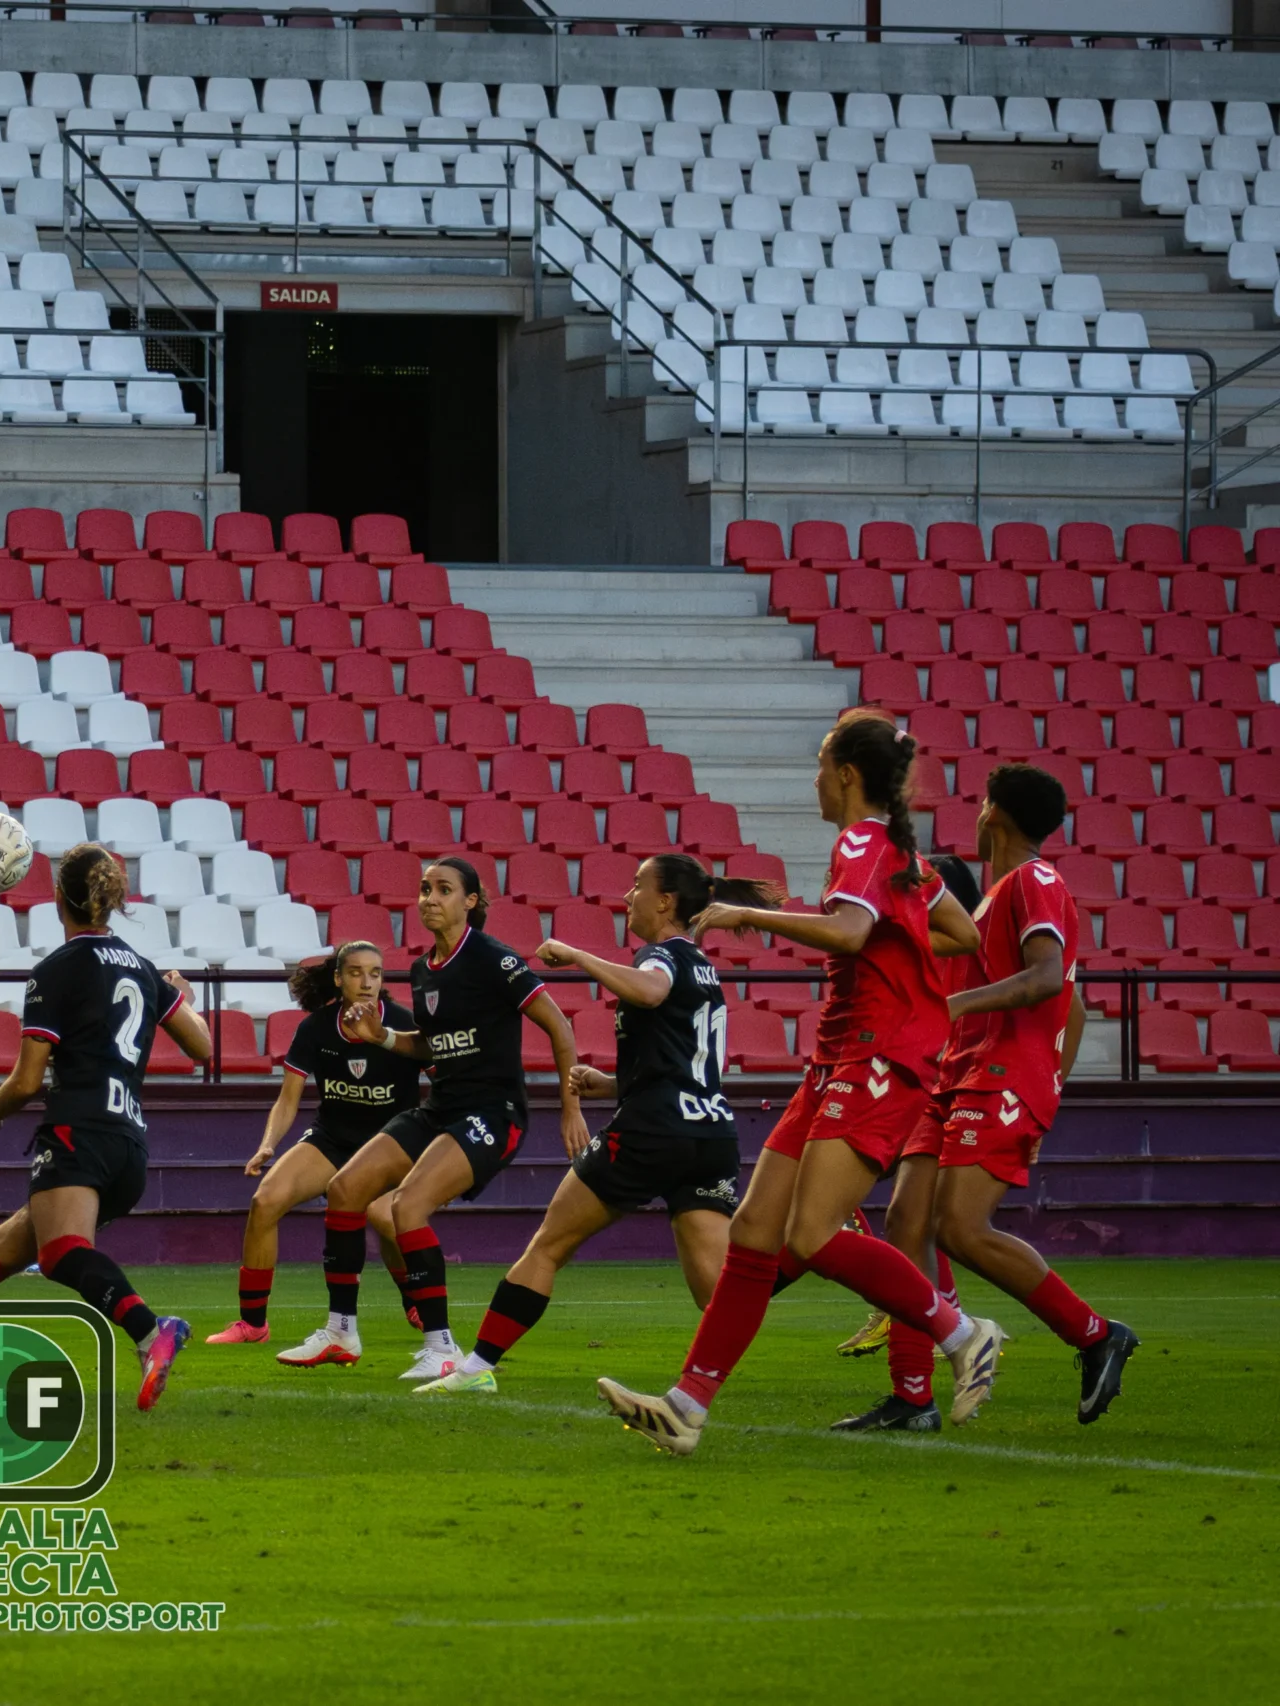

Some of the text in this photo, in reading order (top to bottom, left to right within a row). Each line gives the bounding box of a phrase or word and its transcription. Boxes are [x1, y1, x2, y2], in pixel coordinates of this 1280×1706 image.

[269, 288, 332, 304] SALIDA
[93, 948, 142, 970] MADDI
[112, 977, 145, 1067] 2
[693, 1000, 728, 1088] 11
